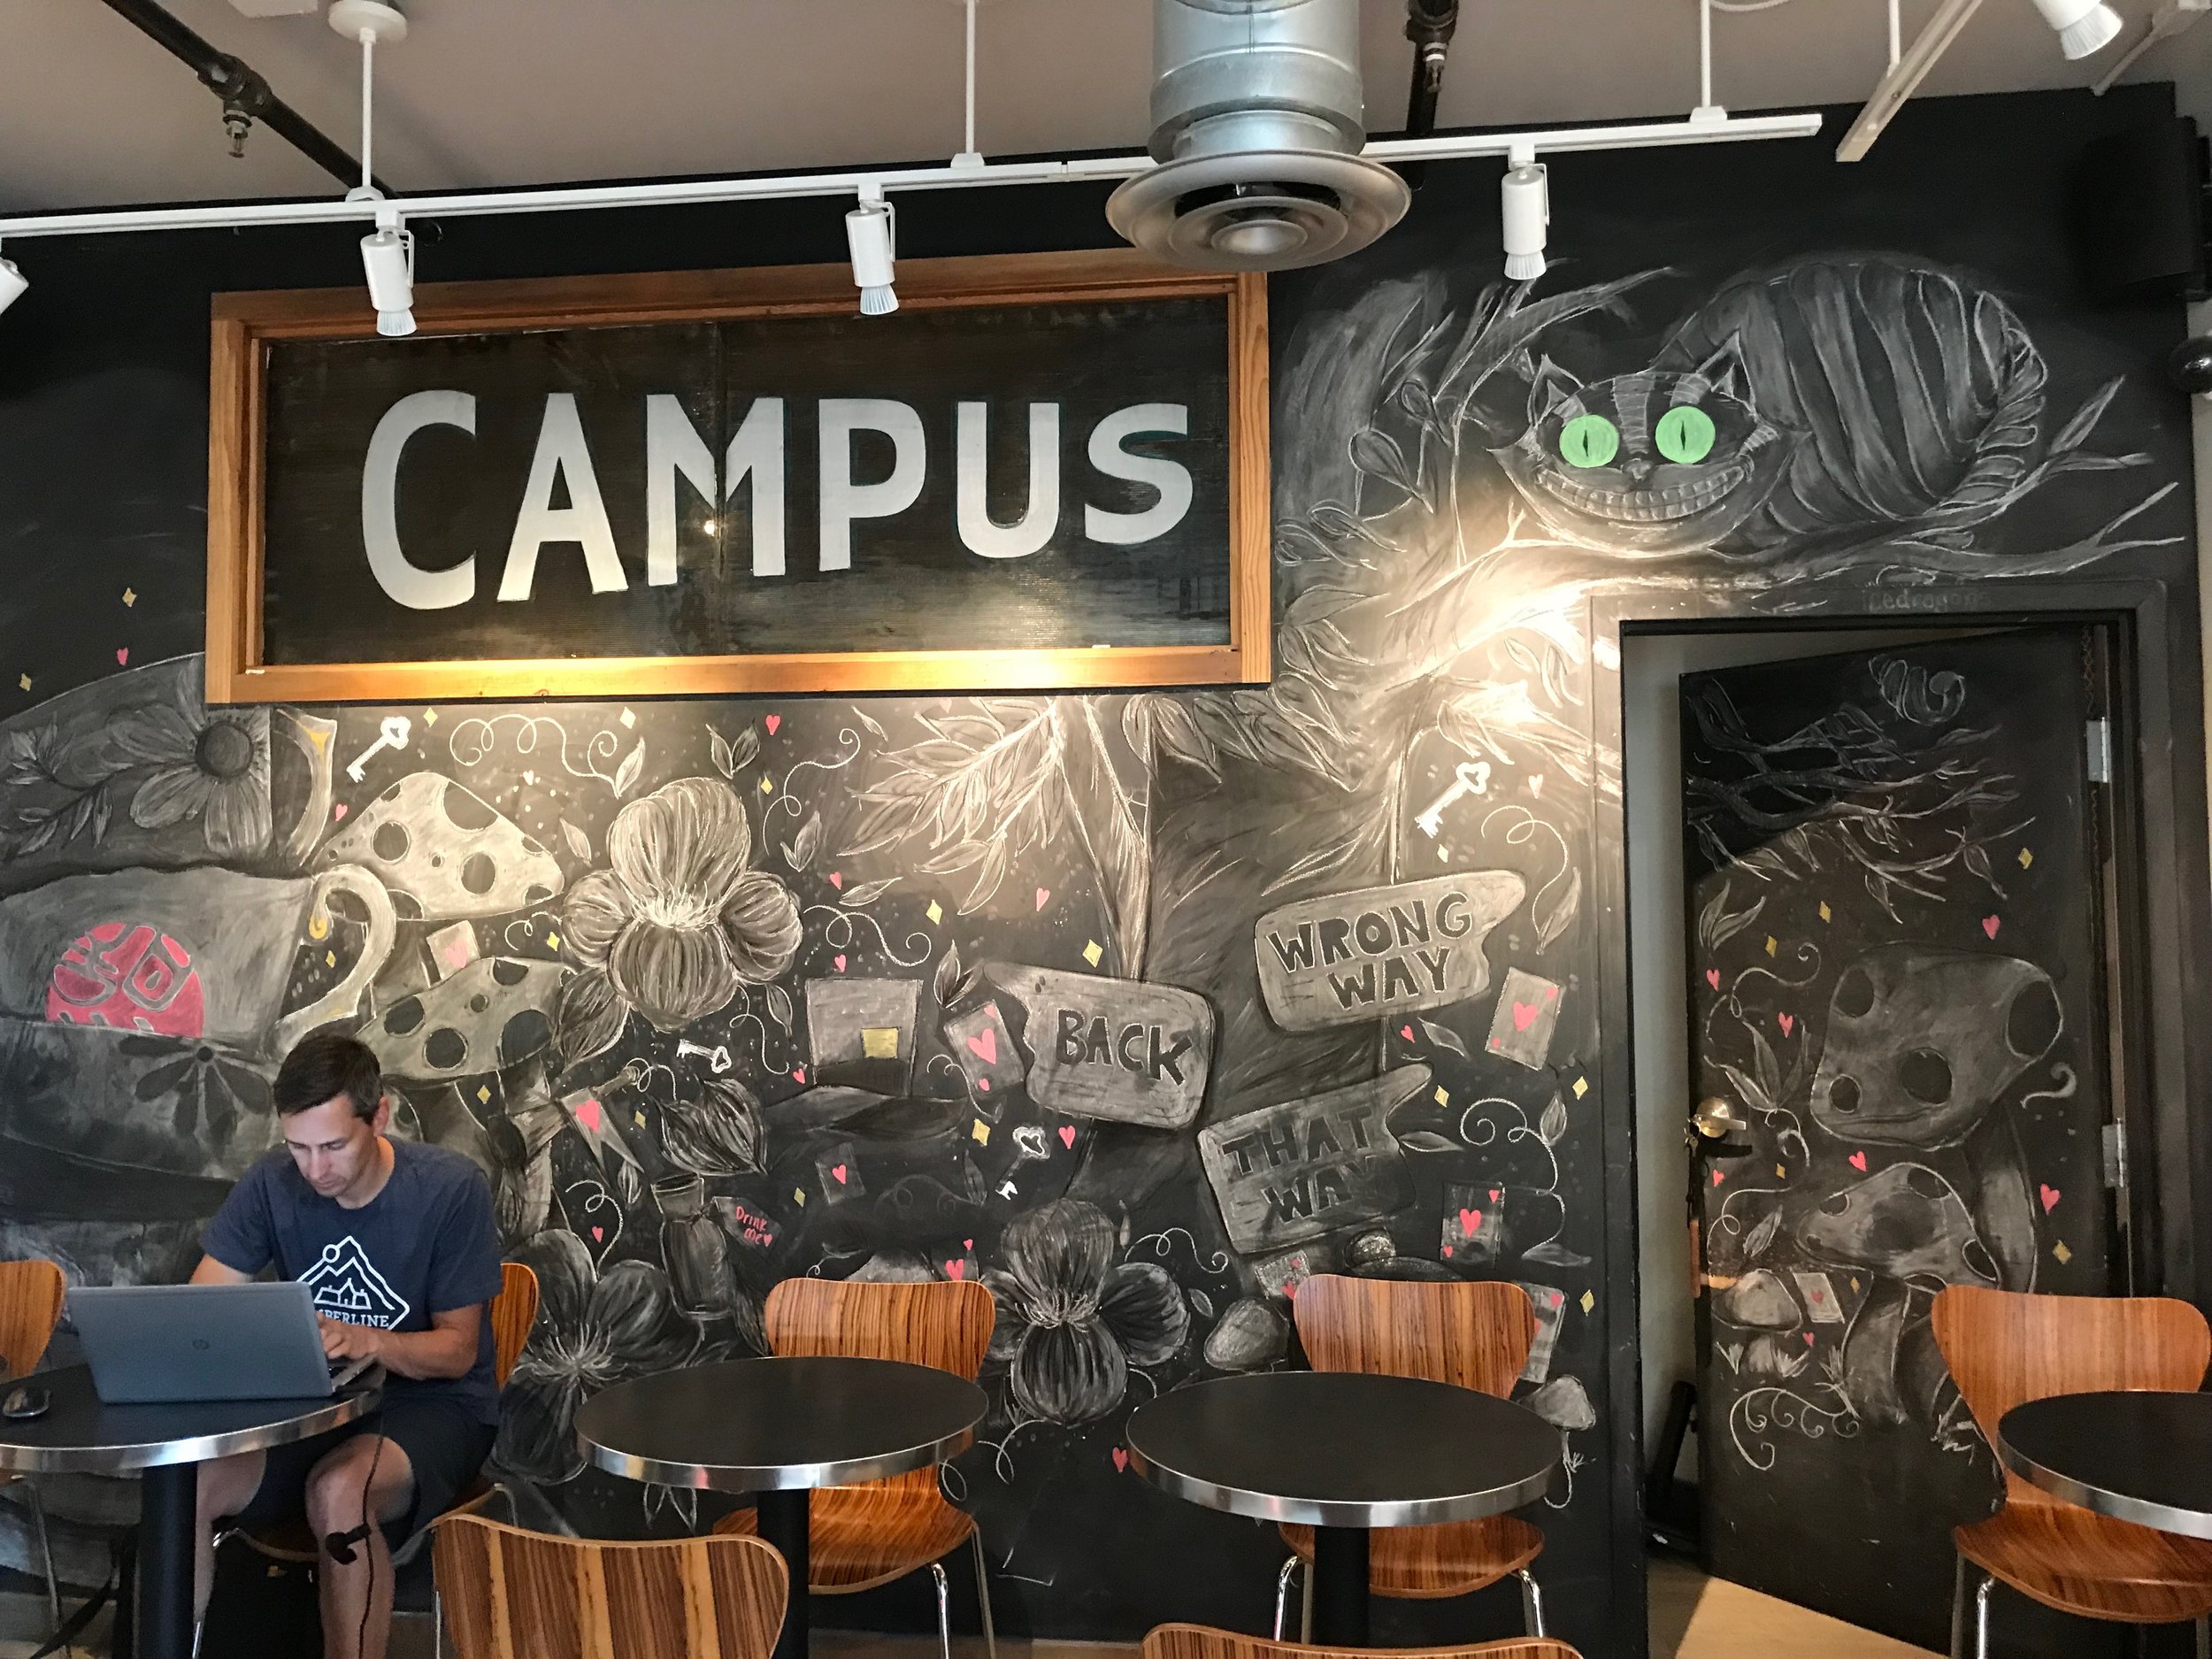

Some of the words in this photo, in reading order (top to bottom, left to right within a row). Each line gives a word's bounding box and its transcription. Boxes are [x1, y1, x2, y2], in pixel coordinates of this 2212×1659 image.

[361, 389, 1194, 611] CAMPUS
[1265, 891, 1472, 973] WRONG
[1327, 947, 1451, 1010] WAY
[1056, 1008, 1193, 1086] BACK
[1222, 1106, 1373, 1175] THAT
[735, 1205, 767, 1231] Drink
[319, 1310, 389, 1327] BERLINE
